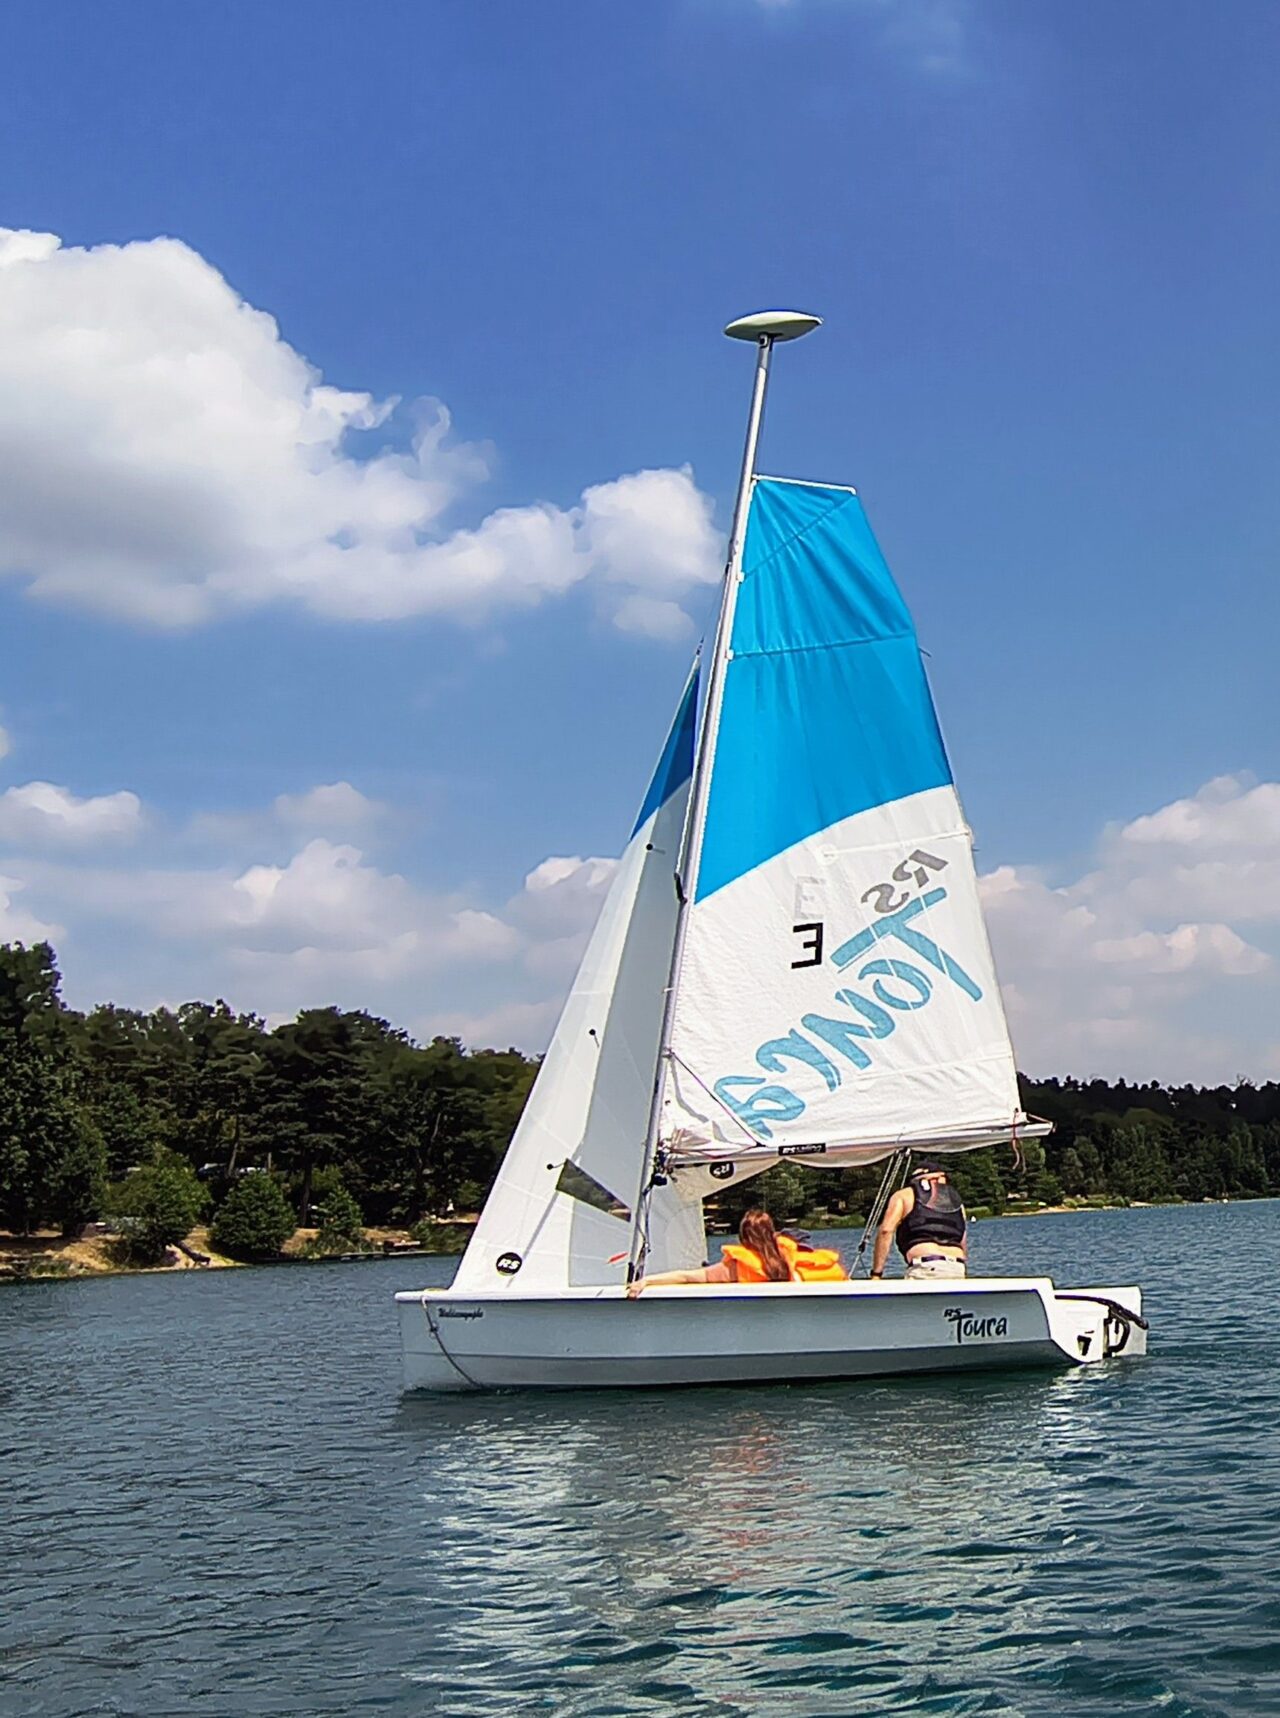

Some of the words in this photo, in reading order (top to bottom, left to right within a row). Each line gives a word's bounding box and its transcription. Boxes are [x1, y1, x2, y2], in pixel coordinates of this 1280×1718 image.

[497, 1258, 521, 1270] RS
[944, 1308, 961, 1317] RS
[948, 1312, 1007, 1344] Toura
